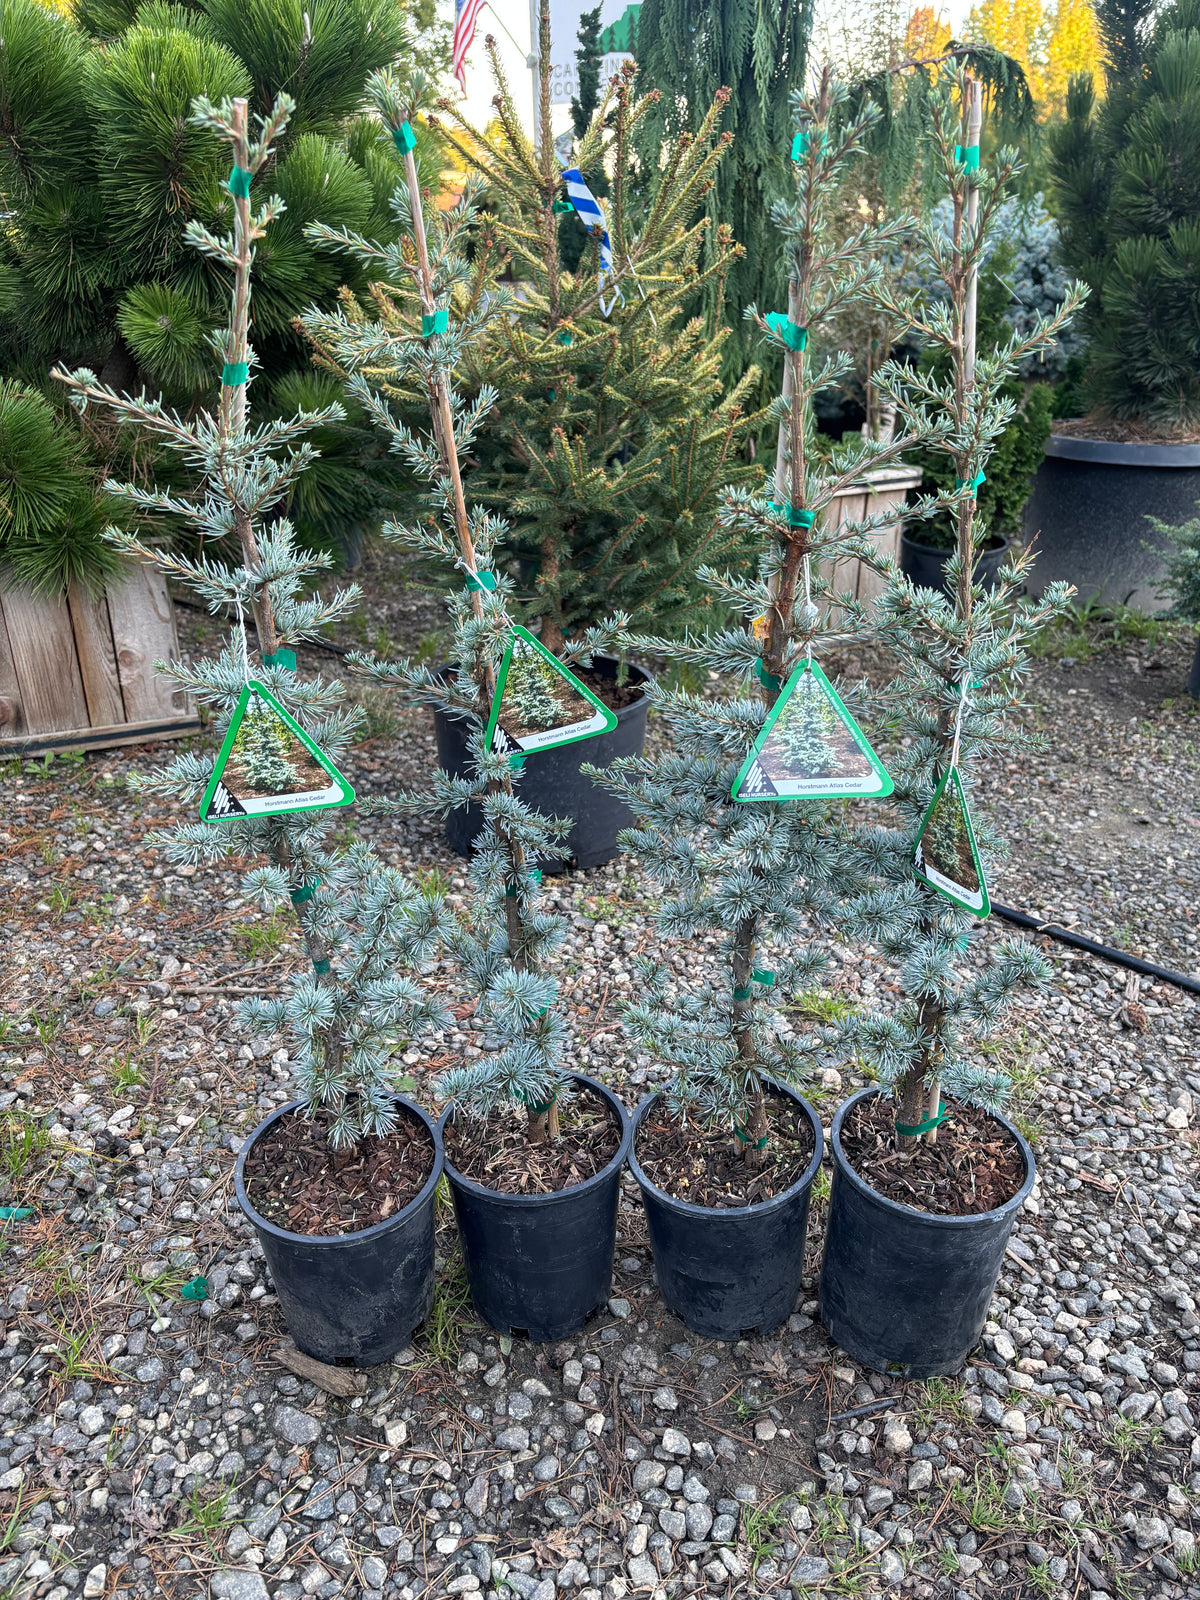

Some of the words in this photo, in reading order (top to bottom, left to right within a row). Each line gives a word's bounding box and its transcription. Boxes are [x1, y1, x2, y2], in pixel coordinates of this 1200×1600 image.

[538, 732, 564, 742] Horstmann
[564, 728, 577, 736] Atlas
[577, 724, 592, 732] Cedar
[265, 799, 294, 807] Horstmann
[294, 796, 308, 804] Atlas
